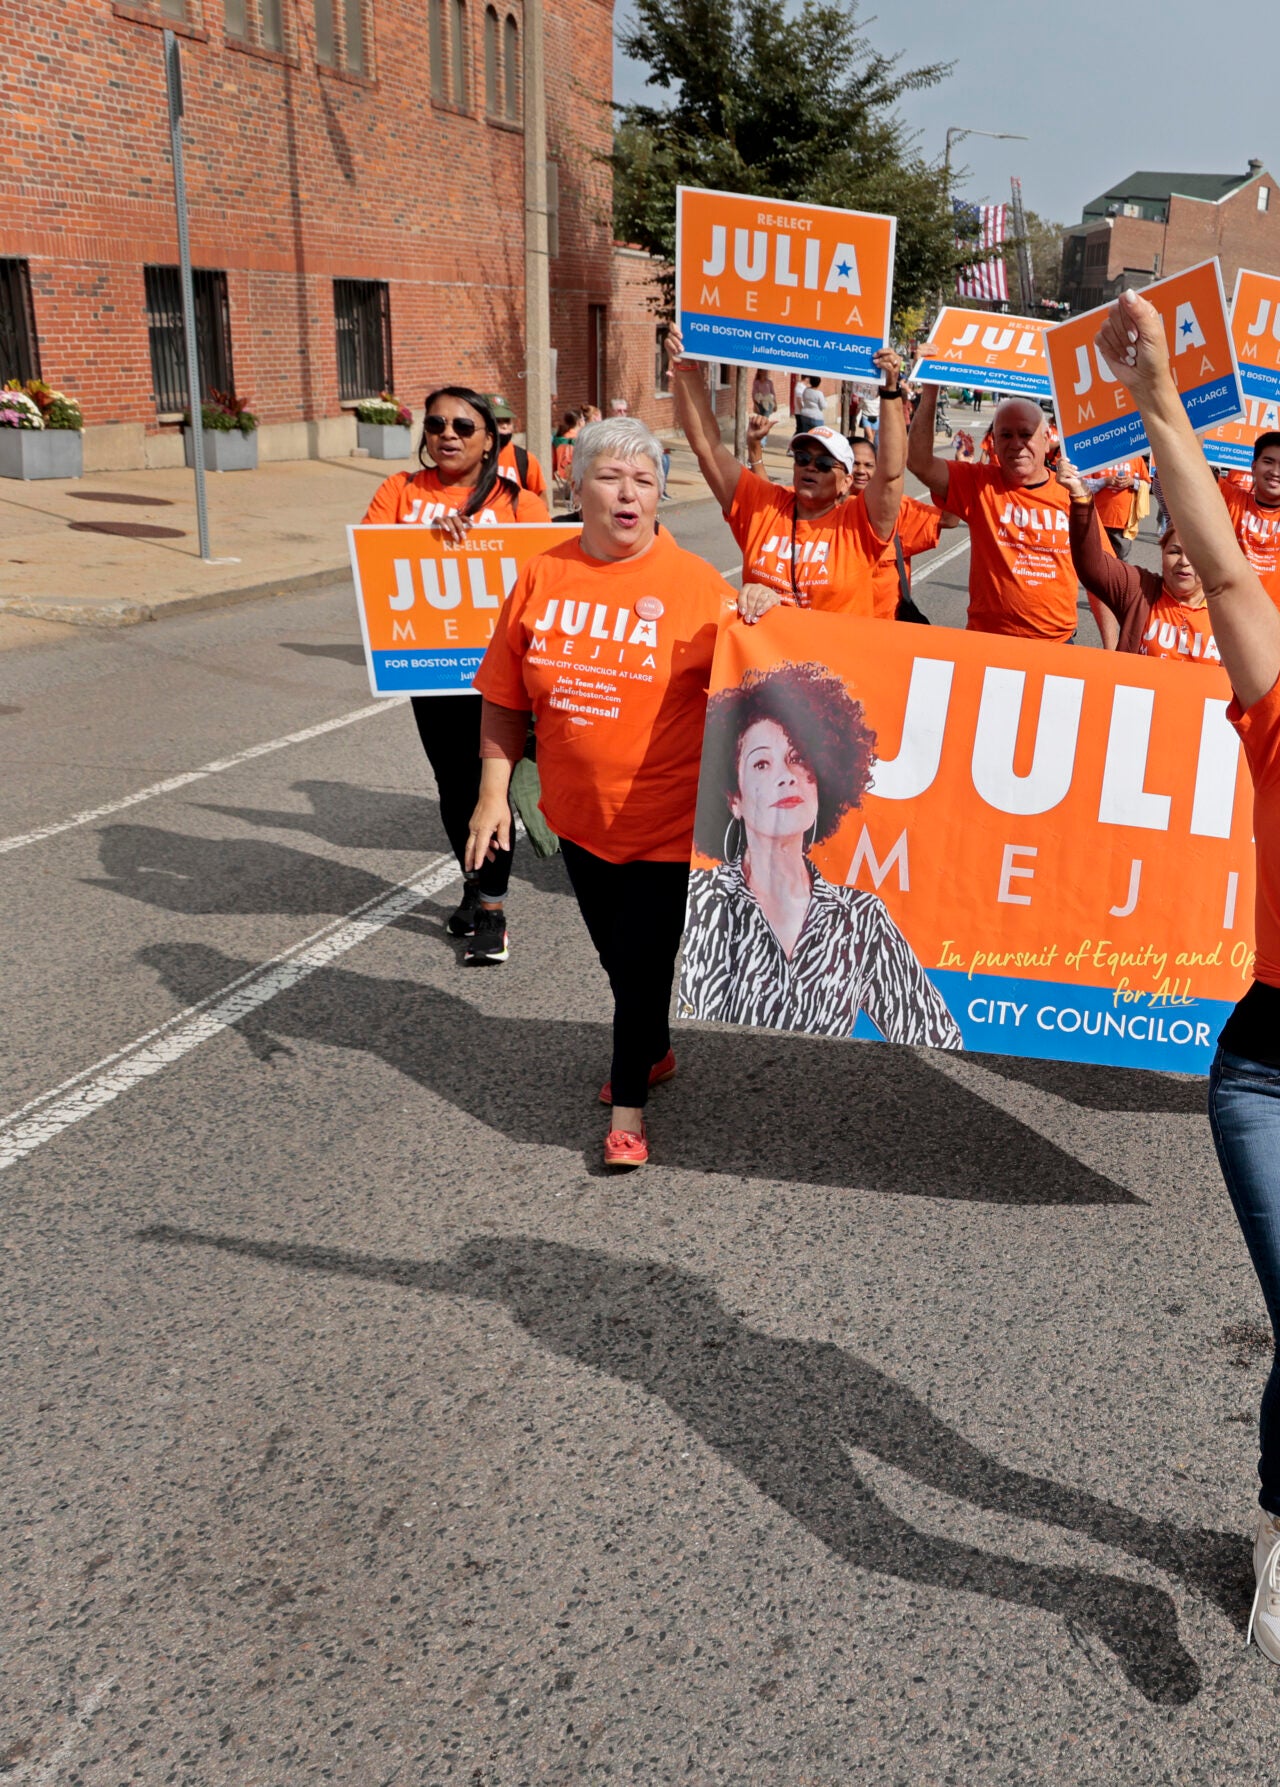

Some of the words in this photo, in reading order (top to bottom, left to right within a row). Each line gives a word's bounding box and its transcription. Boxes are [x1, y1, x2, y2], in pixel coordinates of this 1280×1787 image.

[757, 213, 813, 231] RE-ELECT
[702, 225, 862, 296] JULIA
[700, 284, 863, 327] MEJIA
[690, 322, 711, 333] FOR
[712, 324, 752, 339] BOSTON
[754, 331, 776, 342] CITY
[777, 334, 821, 349] COUNCIL
[823, 341, 872, 355] AT-LARGE
[952, 324, 1047, 357] JUL
[1074, 301, 1206, 396] JUA
[929, 363, 948, 371] FOR
[950, 366, 986, 377] BOSTON
[988, 371, 1008, 380] CITY
[1009, 375, 1049, 386] COUNCIL
[944, 349, 1027, 368] MEJ
[1078, 355, 1215, 424] MEIA
[1246, 372, 1278, 385] BOSTON
[1186, 386, 1229, 409] AT-LARGE
[1074, 438, 1091, 451] FOR
[1093, 426, 1127, 444] BOSTON
[1128, 419, 1144, 433] CIT
[1217, 425, 1258, 441] EJI
[999, 503, 1069, 531] JULIA
[443, 539, 504, 552] RE-ELECT
[388, 558, 518, 611] JULI
[392, 618, 495, 641] MEJ
[535, 599, 657, 648] JULIA
[530, 635, 657, 669] MEJIA
[1143, 619, 1221, 661] JULIA
[385, 659, 408, 669] FOR
[411, 658, 458, 668] BOSTON
[460, 657, 484, 668] CITY
[528, 656, 555, 666] BOSTON
[556, 660, 572, 670] CITY
[573, 664, 617, 677] COUNCILOR
[629, 673, 653, 683] LARGE
[551, 685, 622, 703] juliaforboston.com
[557, 676, 573, 686] Join
[575, 678, 594, 689] Team
[595, 682, 617, 693] Mejia
[548, 697, 620, 719] #allmeansall
[866, 657, 1255, 842] JULI
[845, 823, 1239, 930] MEJI
[936, 940, 965, 968] In
[968, 944, 1058, 981] pursuit
[1064, 939, 1091, 972] of
[1091, 941, 1167, 980] Equity
[1175, 941, 1223, 967] and
[1112, 976, 1147, 1008] for
[967, 998, 1029, 1027] CITY
[1036, 1005, 1210, 1047] COUNCILOR
